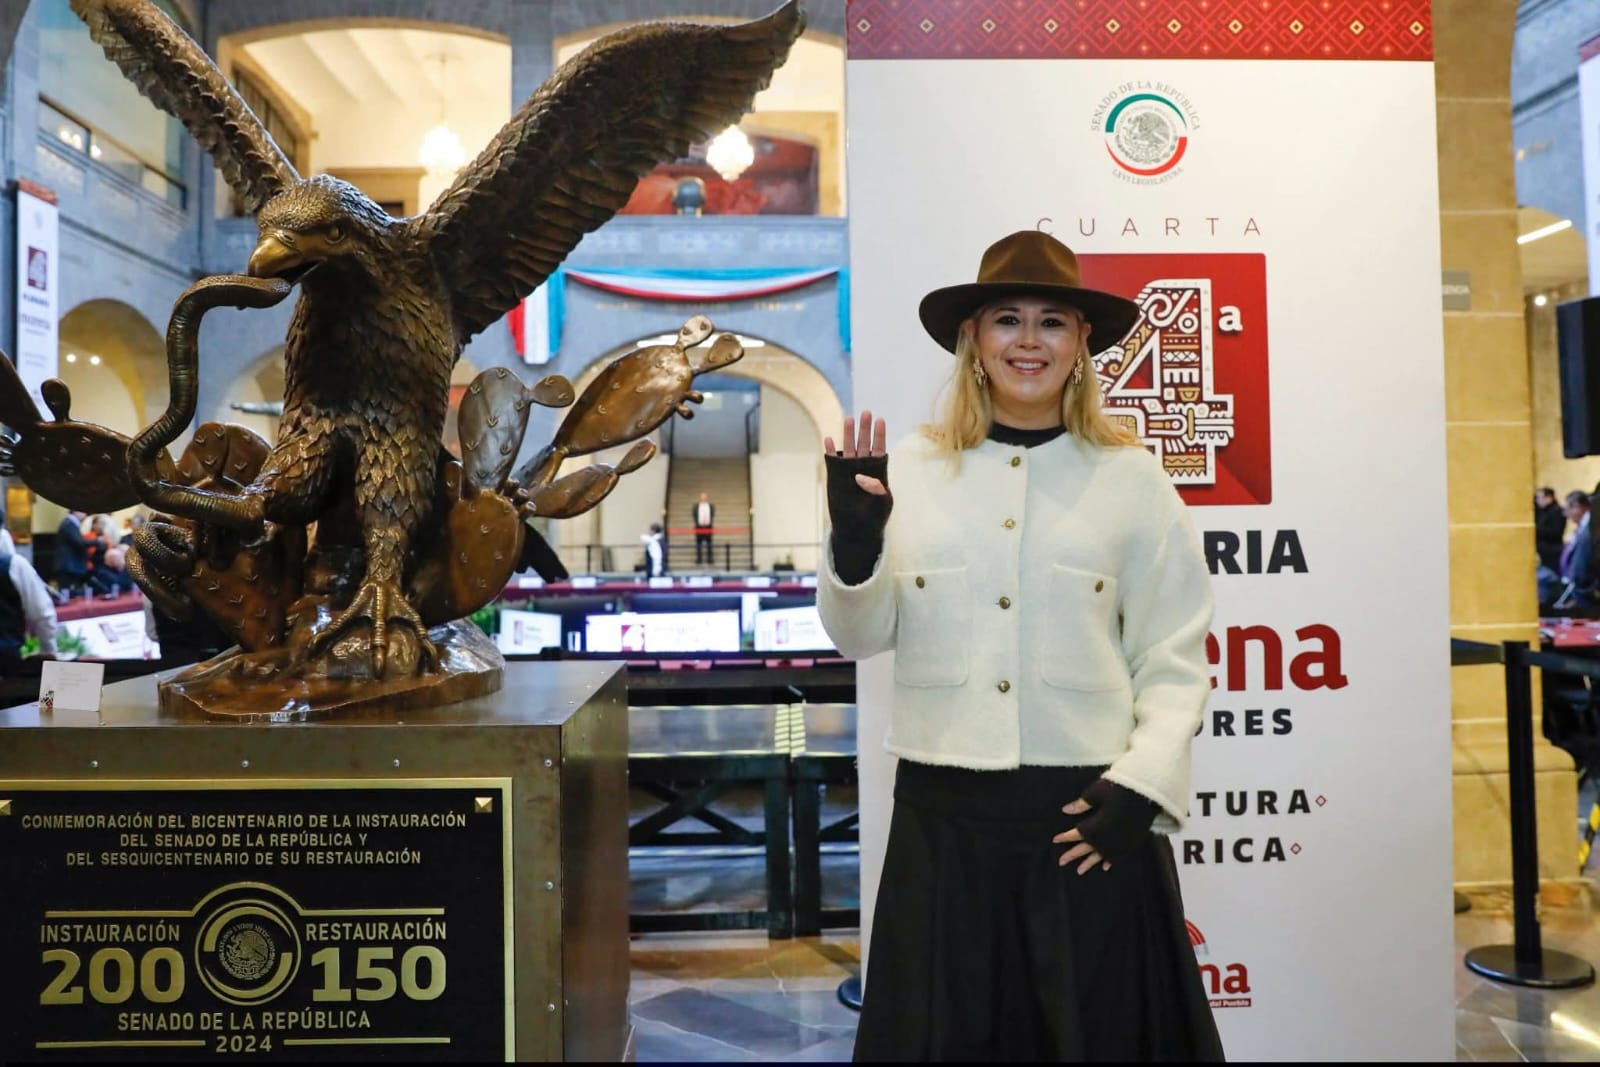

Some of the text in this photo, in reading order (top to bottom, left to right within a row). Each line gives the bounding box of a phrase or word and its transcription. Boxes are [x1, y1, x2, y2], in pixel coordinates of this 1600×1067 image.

[1091, 91, 1118, 131] SENADO
[1118, 81, 1134, 94] DE
[1138, 80, 1152, 89] LA
[1037, 217, 1261, 237] CUARTA
[1194, 708, 1293, 737] RES
[1187, 789, 1311, 817] TURA
[22, 810, 466, 829] CONMEMORACIÓN DEL BICENTENARIO DE LA INSTAURACIÓN
[120, 830, 368, 847] DEL SENADO DE LA REPÚBLICA Y
[66, 847, 421, 867] DEL SESQUICENTENARIO DE SU RESTAURACIÓN
[40, 920, 180, 943] INSTAURACIÓN
[305, 917, 447, 941] RESTAURACIÓN
[40, 947, 186, 1005] 200
[311, 945, 447, 1002] 150
[118, 1007, 371, 1031] SENADO DE LA REPÚBLICA
[216, 1035, 273, 1053] 2024
